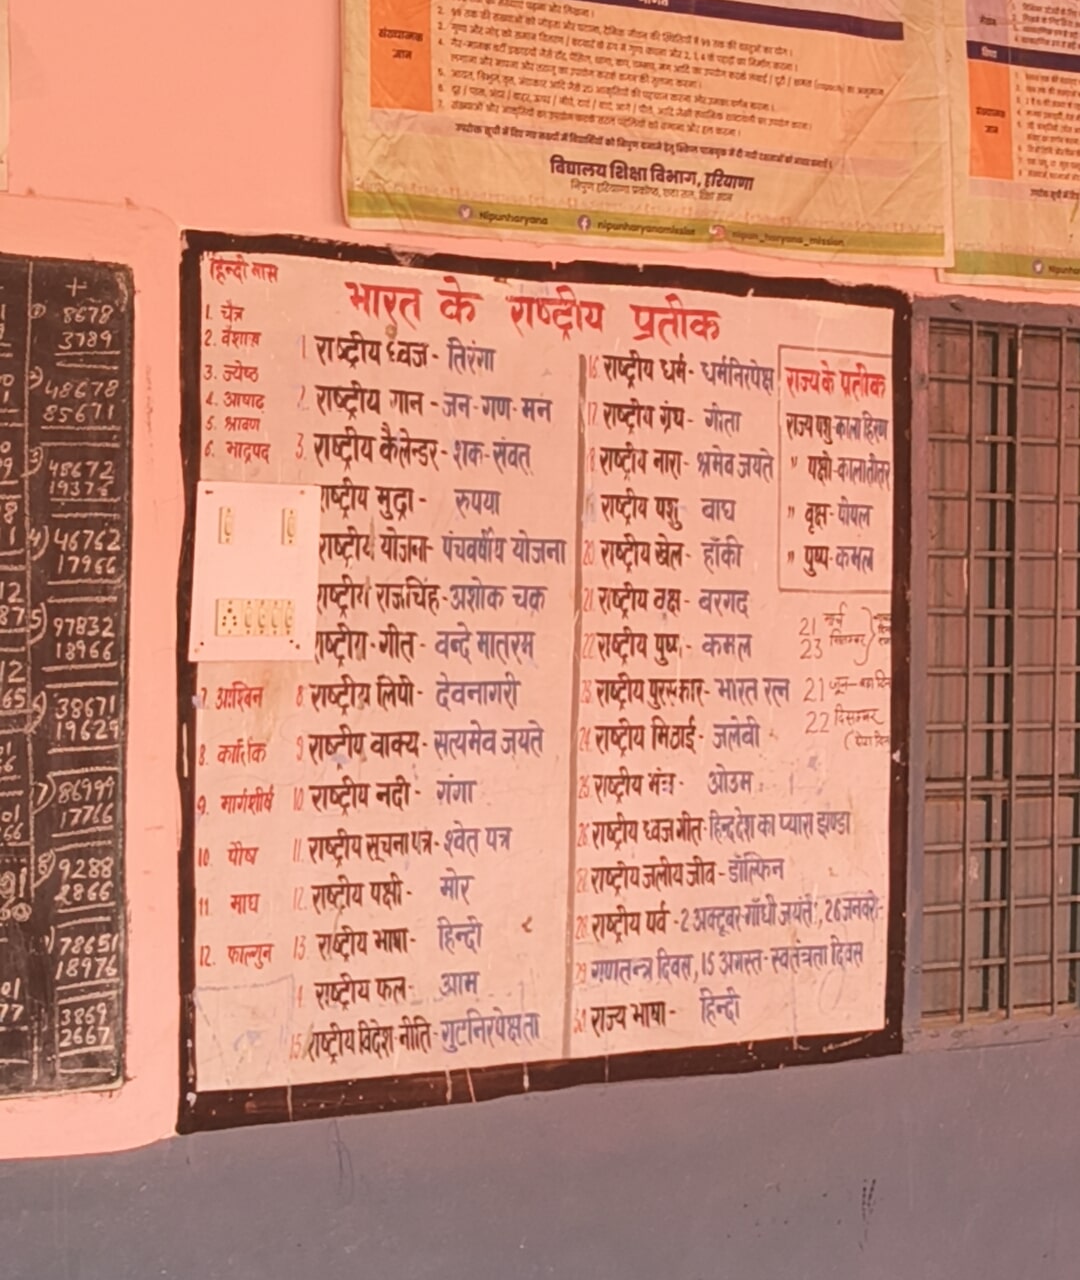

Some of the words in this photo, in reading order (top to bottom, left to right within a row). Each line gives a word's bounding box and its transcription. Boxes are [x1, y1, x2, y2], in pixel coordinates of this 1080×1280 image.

[551, 154, 606, 177] विद्यालय
[610, 160, 647, 182] शिक्षा
[63, 305, 113, 324] 8678
[345, 281, 423, 326] भारत
[437, 276, 483, 325] के
[506, 284, 605, 342] राष्ट्रीय
[630, 293, 721, 346] प्रतीक
[59, 331, 113, 349] 3789
[315, 330, 382, 369] राष्ट्रीय
[447, 338, 495, 372] तिरंगा
[603, 349, 654, 388] राष्ट्रीय
[660, 354, 688, 384] धर्म
[700, 357, 774, 392] धर्मनिरपेक्ष
[785, 364, 820, 397] राज्य
[821, 360, 835, 392] के
[839, 362, 886, 398] प्रतीक
[45, 379, 119, 399] 48678
[43, 404, 114, 422] 85671
[603, 397, 654, 435] राष्ट्रीय
[704, 403, 742, 434] गीता
[48, 461, 114, 479] 48672
[599, 442, 648, 480] राष्ट्रीय
[653, 448, 683, 479] नारा
[739, 446, 774, 483] जयते
[600, 487, 648, 526] राष्ट्रीय
[655, 494, 683, 531] पशु
[701, 497, 735, 520] बाघ
[837, 497, 873, 529] पीपल
[58, 555, 115, 574] 17966
[835, 546, 874, 573] कमल
[53, 617, 115, 637] 97832
[798, 617, 816, 635] 21
[56, 640, 114, 660] 18966
[597, 626, 647, 668] राष्ट्रीय
[701, 634, 752, 660] कमल
[800, 639, 822, 659] 23
[310, 673, 371, 715] राष्ट्रीय
[436, 671, 521, 711] देवनागरी
[594, 672, 645, 711] राष्ट्रीय
[647, 675, 704, 709] पुरस्कार
[718, 677, 758, 706] भारत
[762, 679, 789, 704] रत्न
[803, 677, 824, 702] 21
[56, 696, 116, 719] 38671
[595, 718, 645, 758] राष्ट्रीय
[651, 715, 696, 753] मिठाई
[713, 721, 760, 753] जलेबी
[805, 711, 830, 734] 22
[308, 725, 366, 769] राष्ट्रीय
[371, 730, 420, 759] वाक्य
[434, 719, 496, 759] सत्यमेव
[502, 720, 544, 755] जयते
[310, 775, 370, 817] राष्ट्रीय
[376, 775, 411, 810] नदी
[436, 774, 477, 805] गंगा
[61, 803, 113, 828] 17766
[308, 828, 362, 870] राष्ट्रीय
[443, 821, 481, 855] श्वेत
[485, 826, 512, 851] पत्र
[59, 857, 113, 880] 9288
[590, 861, 640, 899] राष्ट्रीय
[642, 859, 683, 899] जलीय
[688, 857, 716, 890] जीव
[230, 893, 260, 914] माघ
[311, 875, 365, 915] राष्ट्रीय
[370, 871, 404, 907] पक्षी
[440, 867, 475, 904] मोर
[60, 934, 119, 955] 78651
[317, 925, 367, 962] राष्ट्रीय
[374, 928, 408, 954] भाषा
[437, 915, 483, 954] हिन्दी
[56, 955, 117, 980] 18976
[314, 973, 370, 1012] राष्ट्रीय
[376, 975, 406, 1000] फल
[439, 972, 480, 996] आम
[61, 1003, 107, 1025] 3869
[590, 1007, 627, 1041] राज्य
[631, 1003, 666, 1030] भाषा
[700, 988, 742, 1030] हिन्दी
[60, 1027, 110, 1047] 2667
[307, 1023, 355, 1065] राष्ट्रीय
[359, 1024, 395, 1056] विदेश
[399, 1017, 432, 1054] नीति
